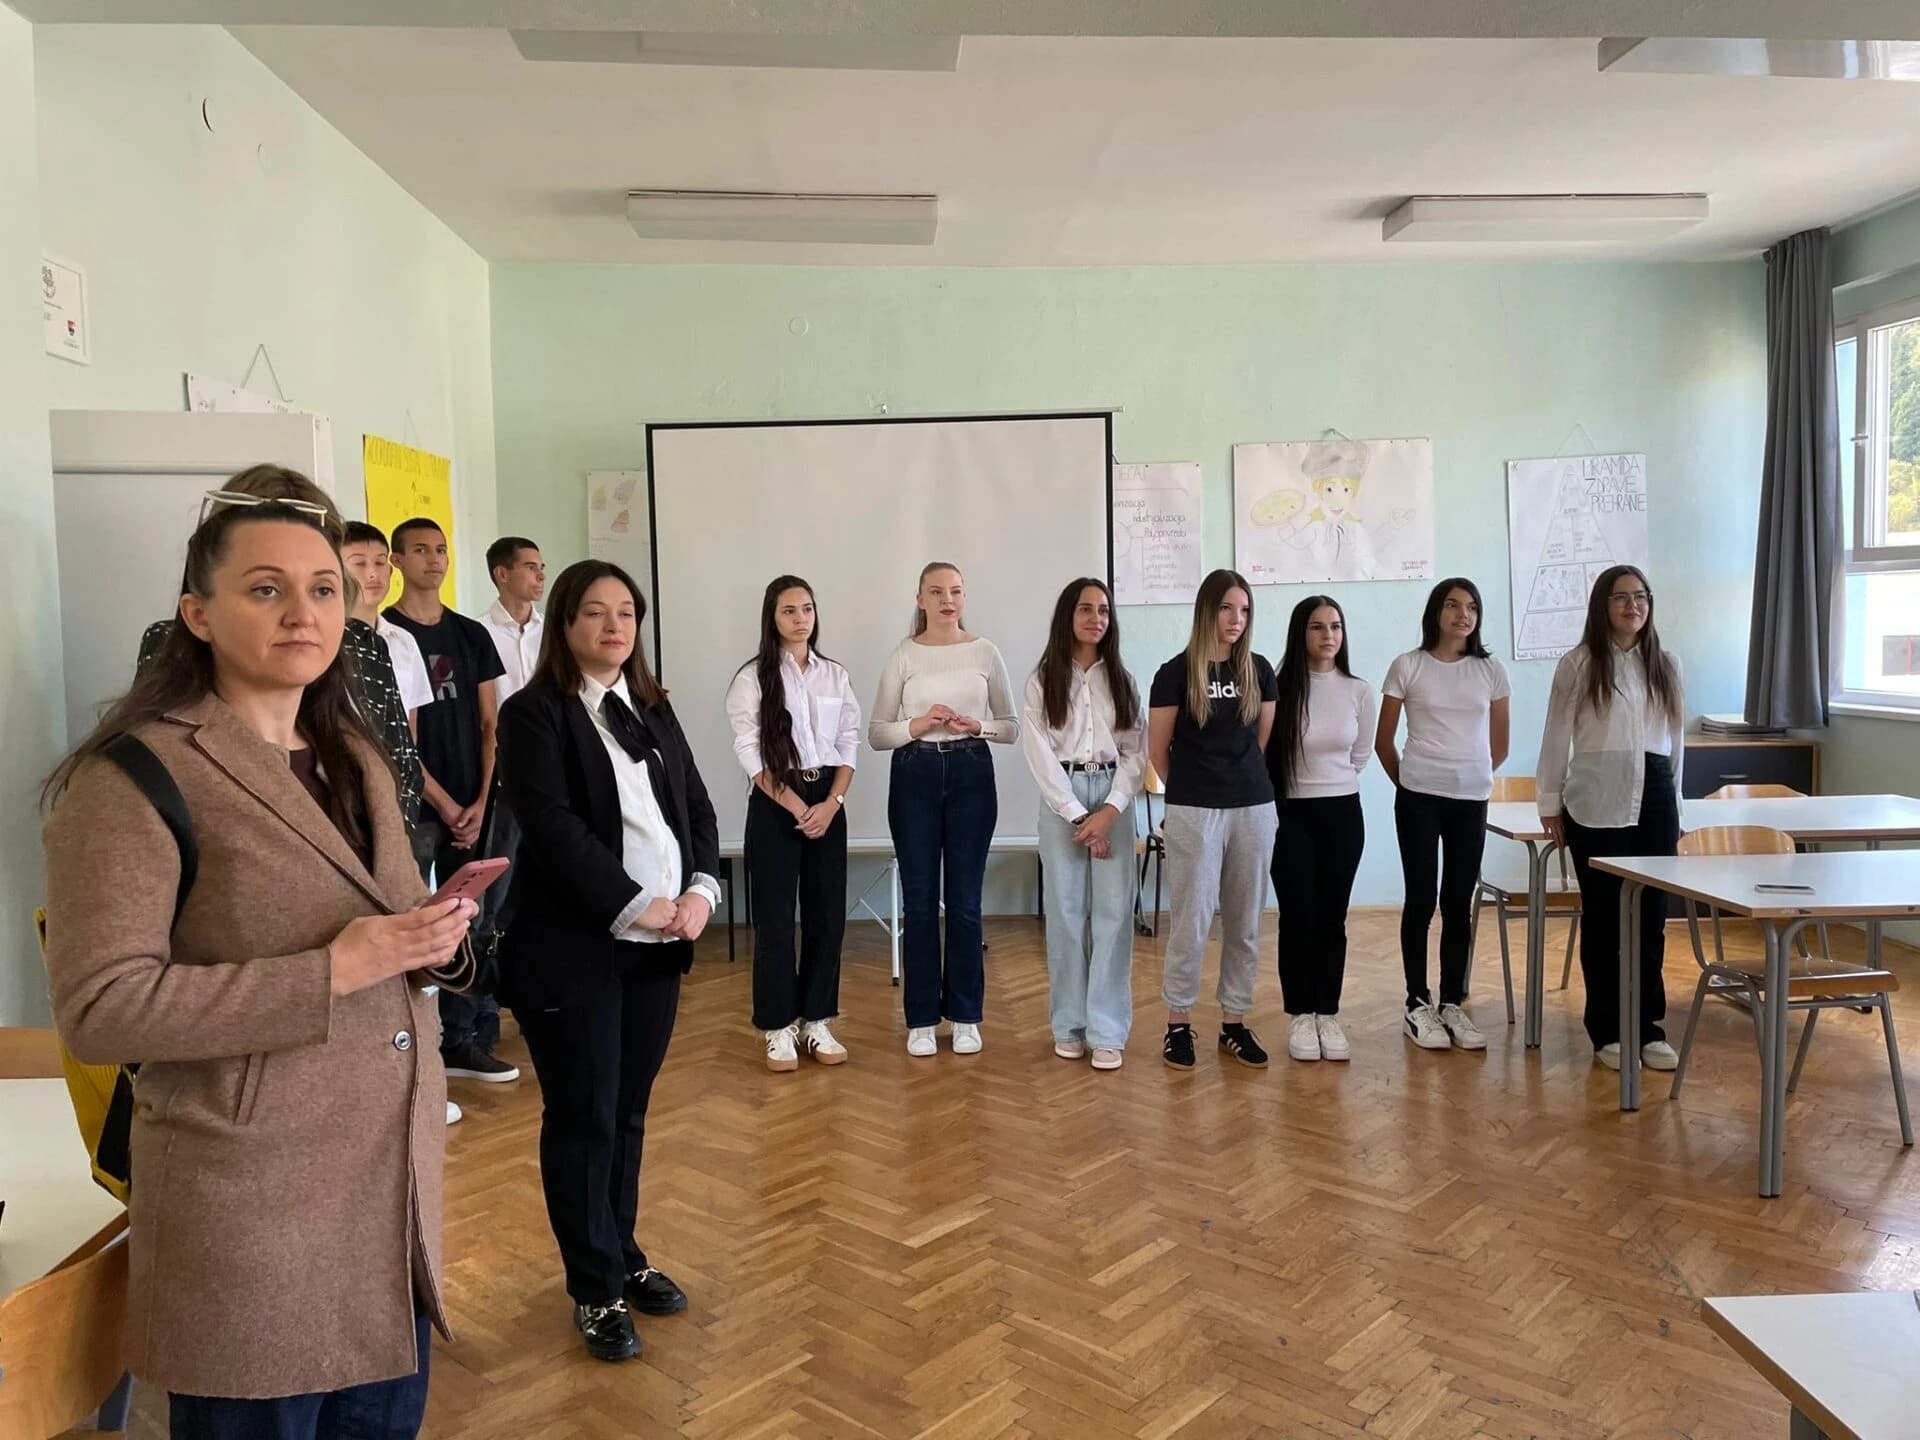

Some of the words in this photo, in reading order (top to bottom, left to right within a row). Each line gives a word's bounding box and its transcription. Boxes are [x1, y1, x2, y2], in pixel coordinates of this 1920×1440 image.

[1584, 475, 1638, 495] ZDRAVE
[1591, 493, 1647, 513] PREHRANE
[1207, 680, 1243, 699] did
